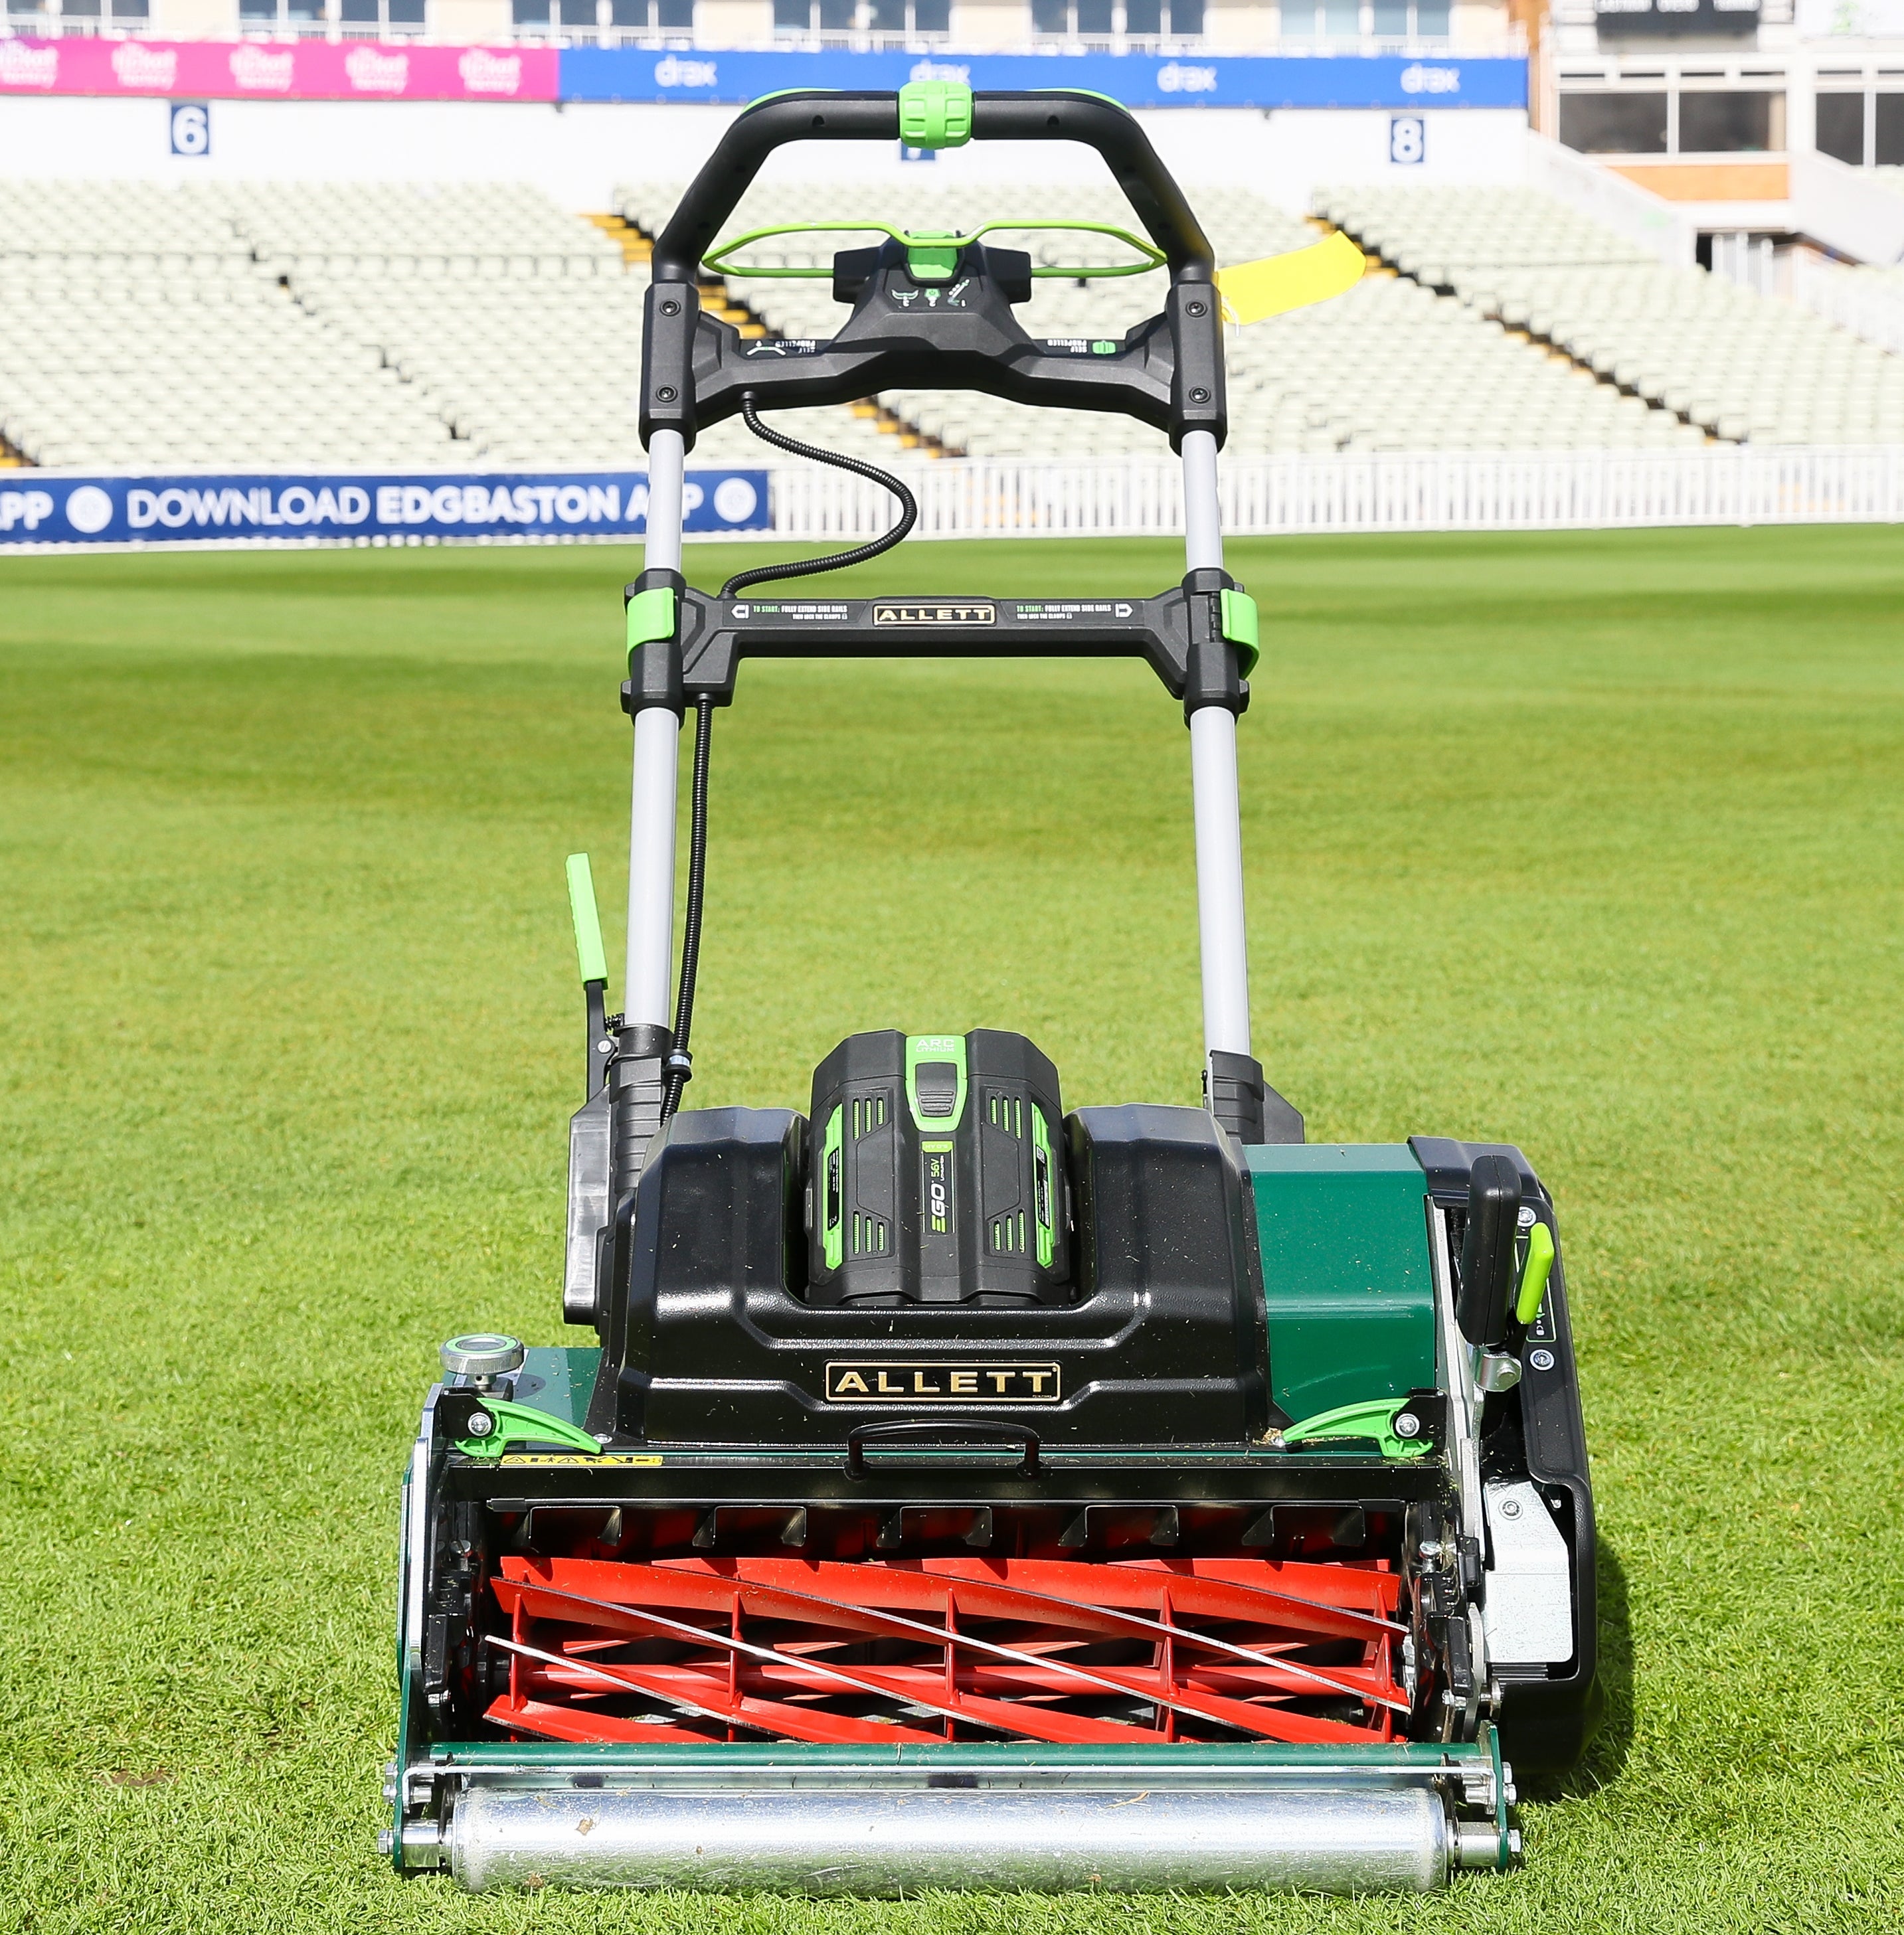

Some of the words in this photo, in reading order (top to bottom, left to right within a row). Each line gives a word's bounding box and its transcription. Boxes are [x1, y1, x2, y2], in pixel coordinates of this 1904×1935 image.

[654, 53, 718, 88] drax
[1156, 60, 1217, 93] drax
[1400, 62, 1460, 94] drax
[172, 106, 208, 153] 6
[1393, 117, 1423, 163] 8
[0, 490, 54, 531] PP
[127, 485, 371, 529] DOWNLOAD
[376, 484, 620, 525] EDGBASTON
[625, 483, 704, 522] AP
[879, 609, 990, 621] ALLETT
[916, 1039, 955, 1048] ARC
[931, 1158, 940, 1177] 56V
[931, 1183, 946, 1233] EGO
[835, 1371, 1052, 1392] ALLETT
